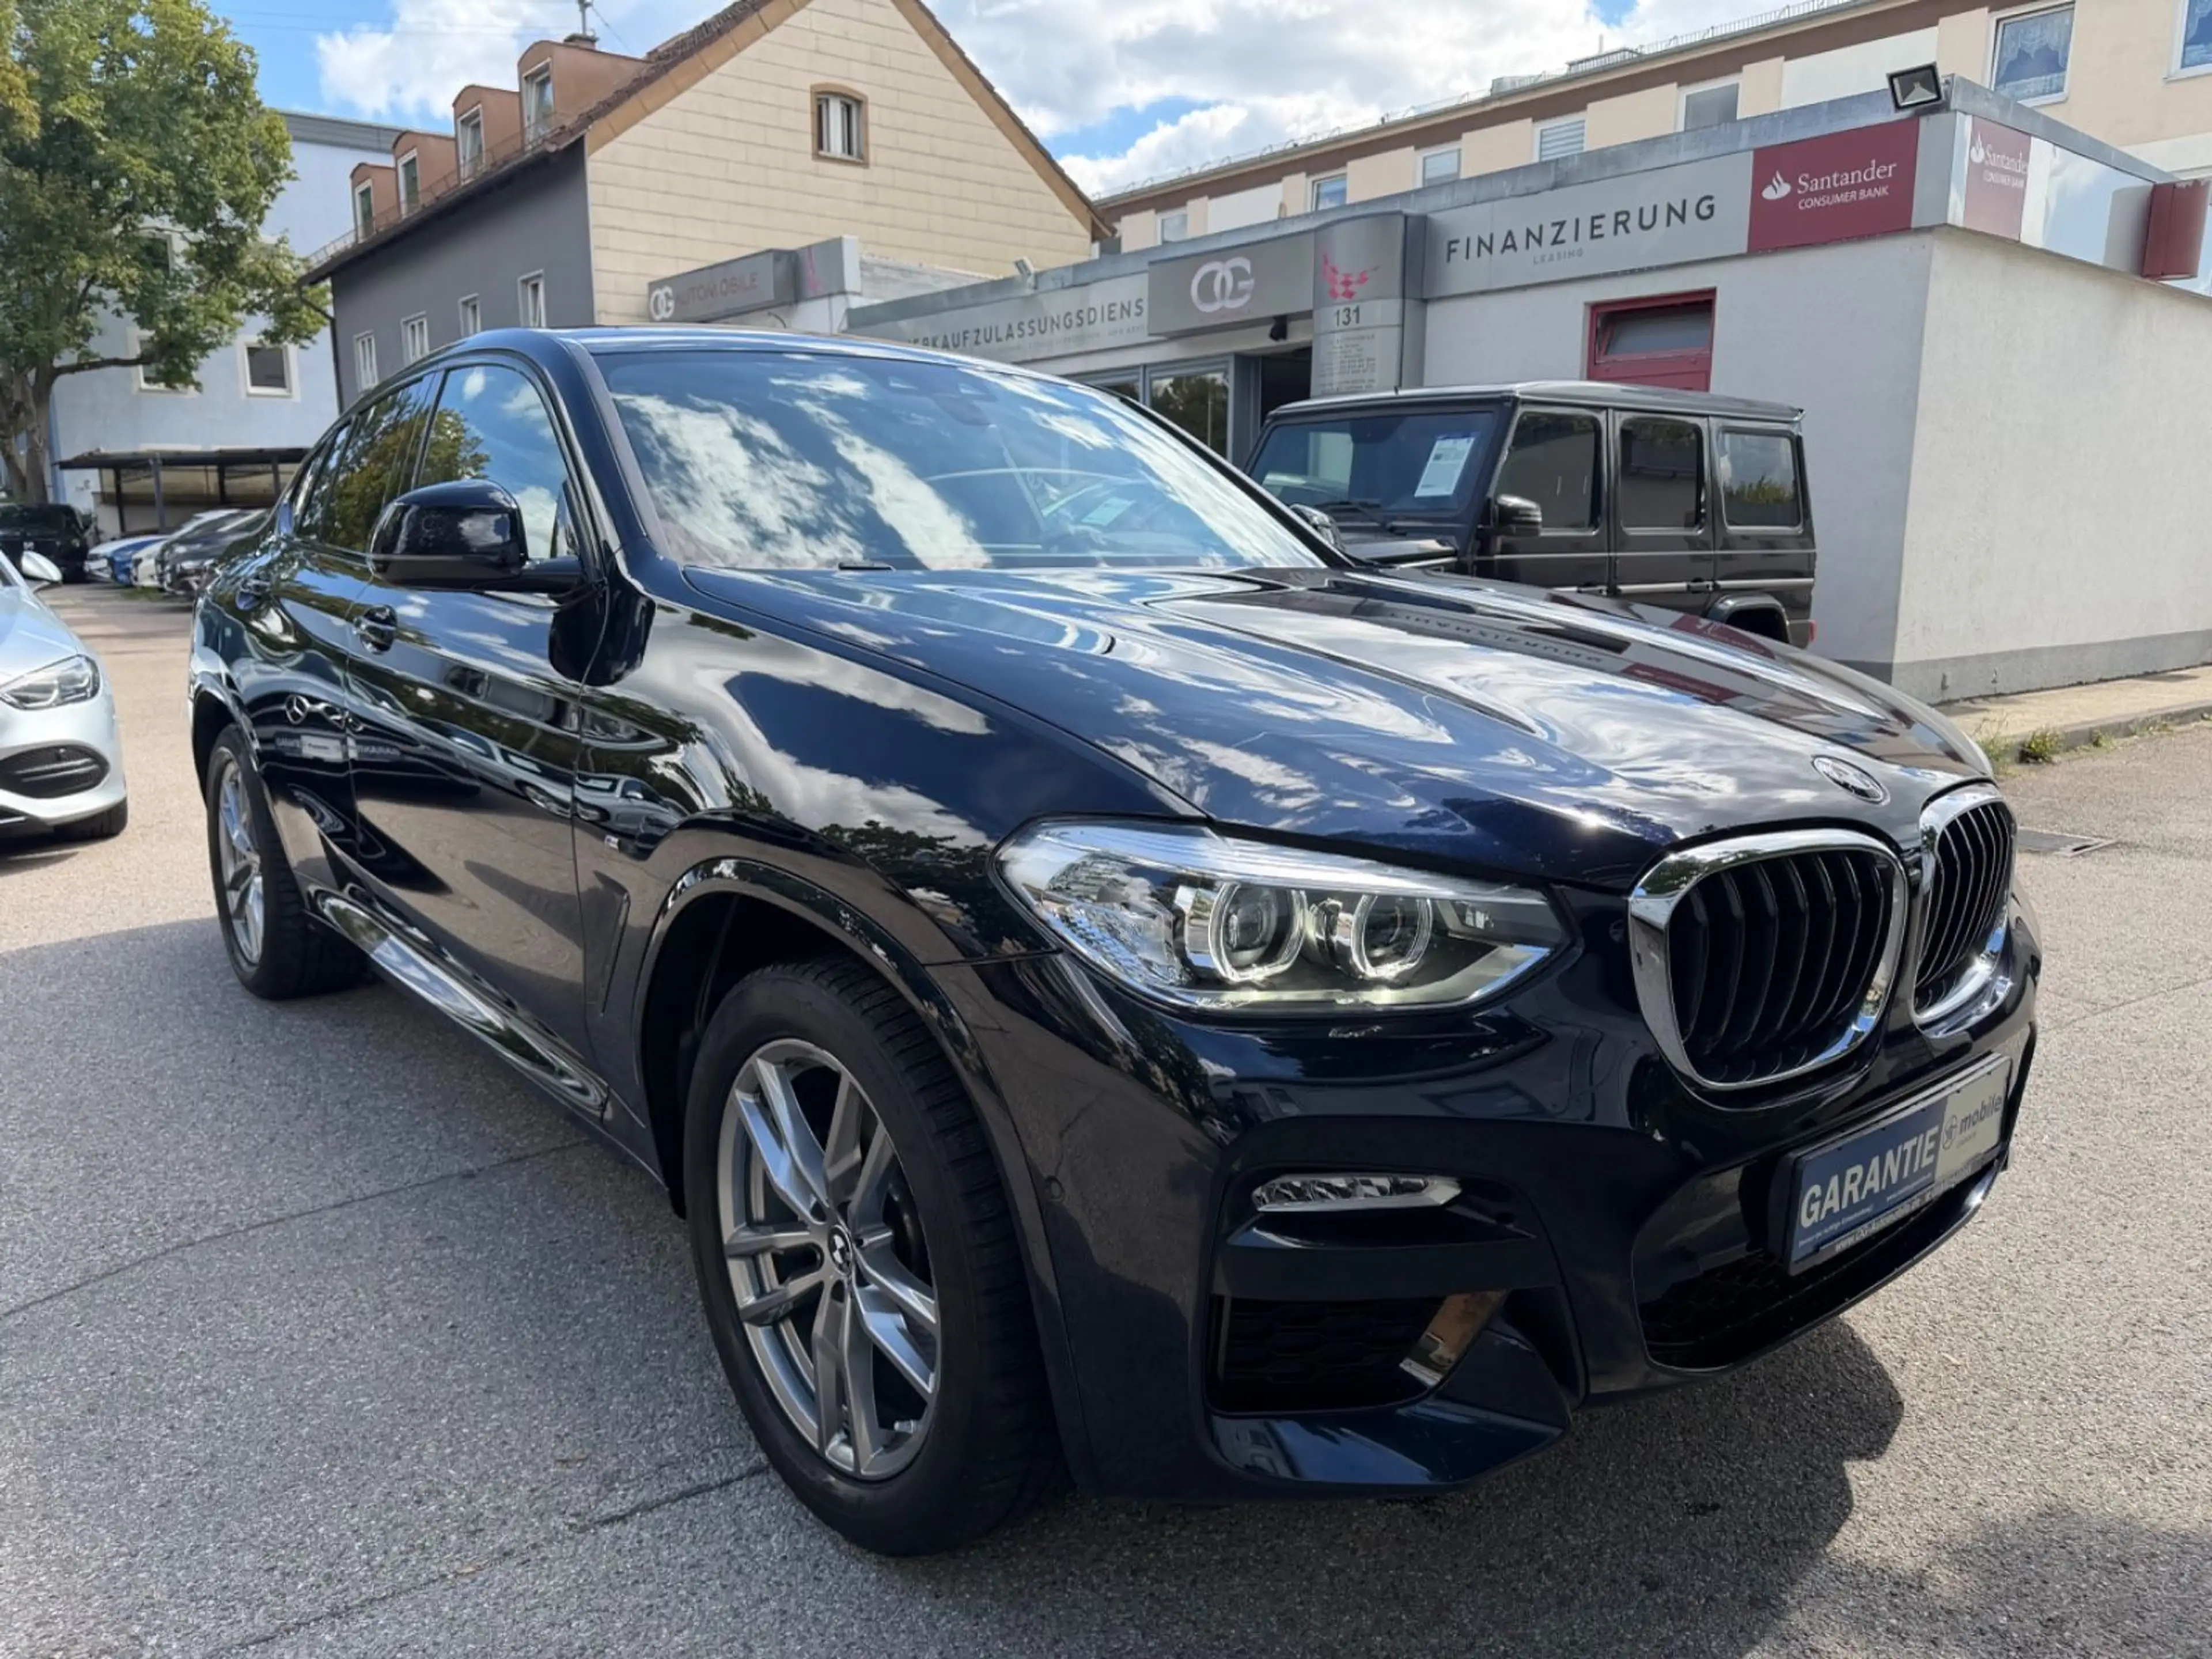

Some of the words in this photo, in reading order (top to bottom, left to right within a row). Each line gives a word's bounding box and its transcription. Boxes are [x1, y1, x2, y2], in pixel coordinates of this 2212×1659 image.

[1797, 159, 1896, 194] Santander
[1798, 189, 1857, 210] CONSUMER
[1858, 185, 1889, 200] BANK
[1446, 195, 1715, 263] FINANZIERUNG
[1532, 248, 1585, 265] LEASING
[1335, 305, 1360, 327] 131
[1801, 1125, 1940, 1228] GARANTIE
